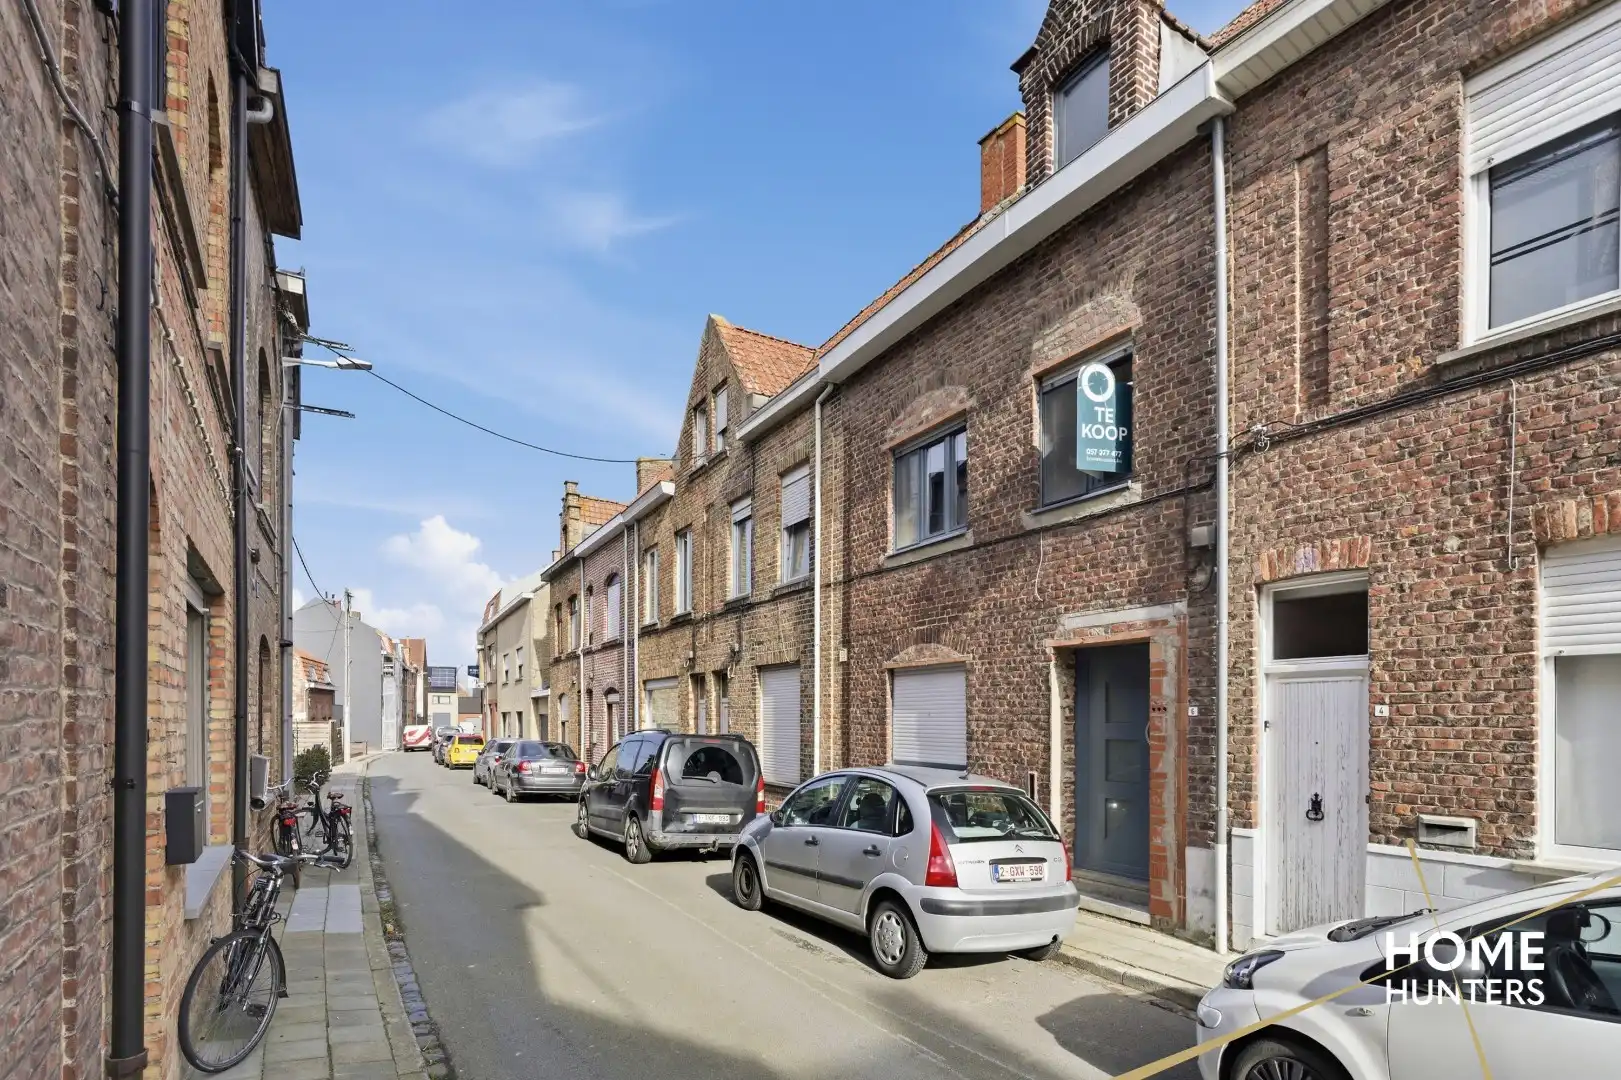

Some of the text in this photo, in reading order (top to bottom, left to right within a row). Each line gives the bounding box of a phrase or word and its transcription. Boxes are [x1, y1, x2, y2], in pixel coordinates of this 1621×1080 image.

[1094, 406, 1114, 423] TE
[1081, 423, 1128, 441] KOOP
[1000, 864, 1043, 877] 2-GXW-598
